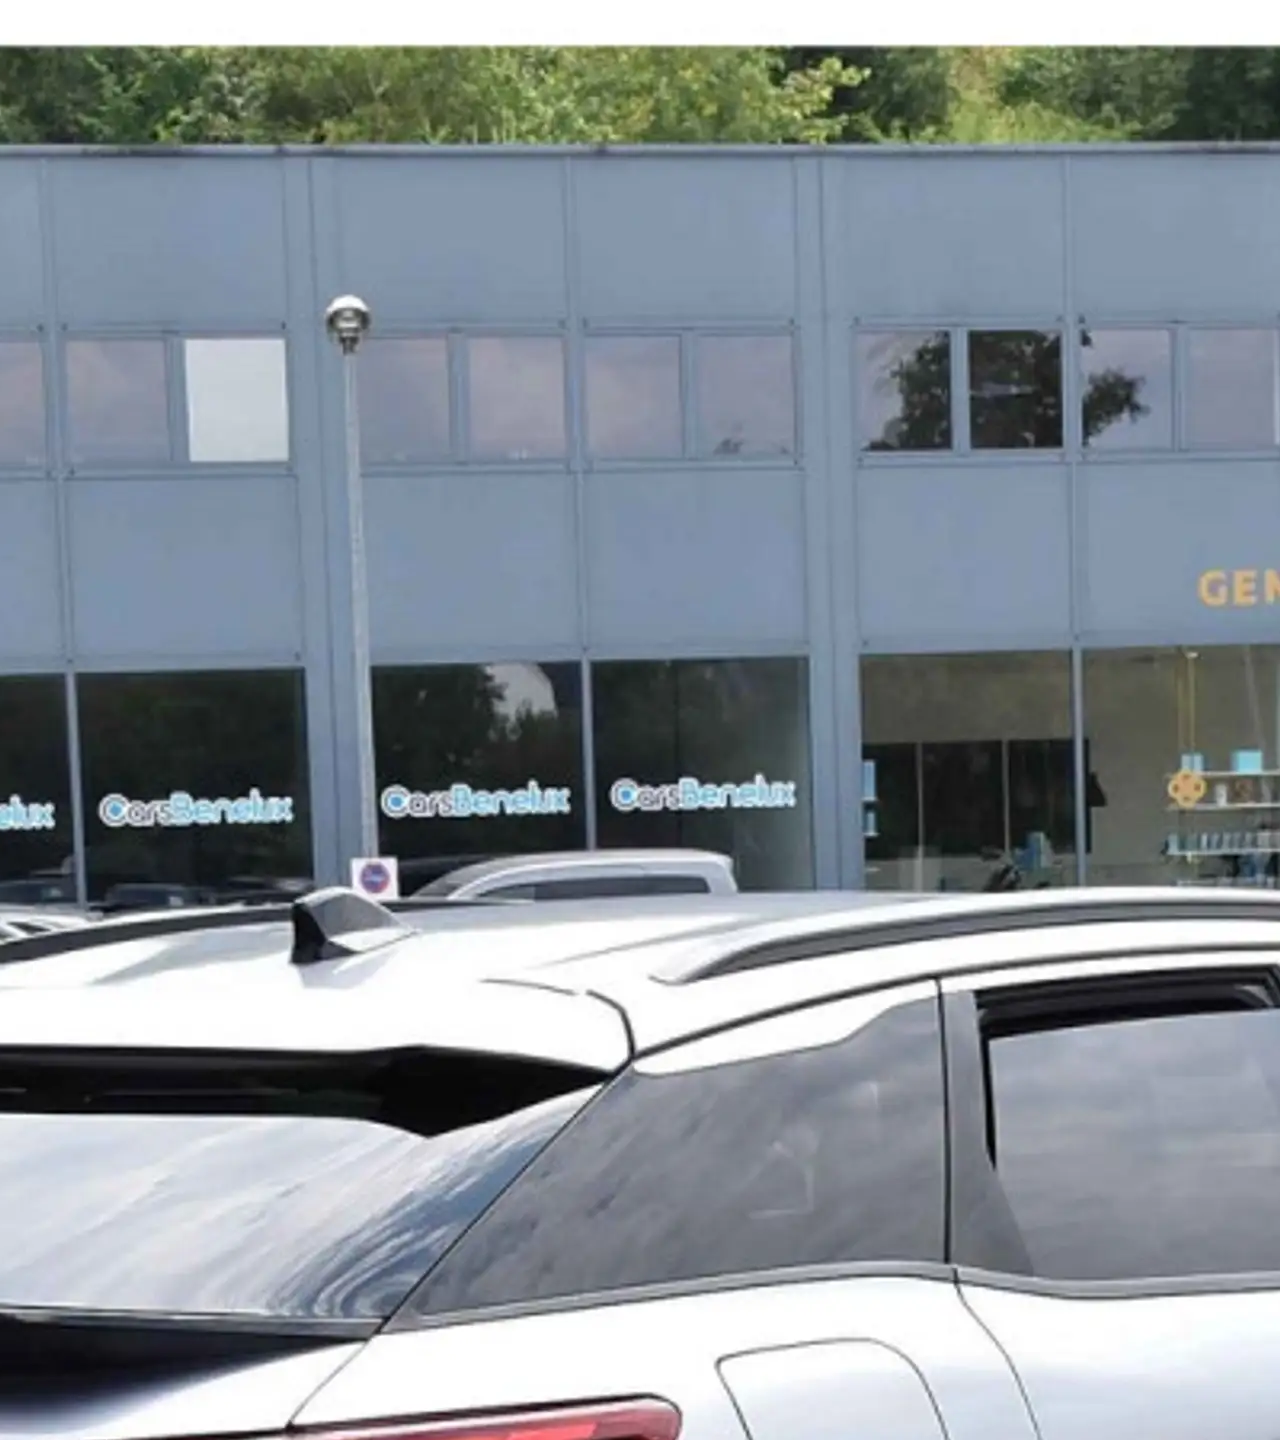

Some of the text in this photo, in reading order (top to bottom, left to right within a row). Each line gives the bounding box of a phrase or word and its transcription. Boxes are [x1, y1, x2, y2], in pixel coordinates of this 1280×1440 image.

[99, 787, 295, 829] CarsBenelux
[381, 778, 571, 818] CarsBenelux
[610, 773, 797, 812] CarsBenelux
